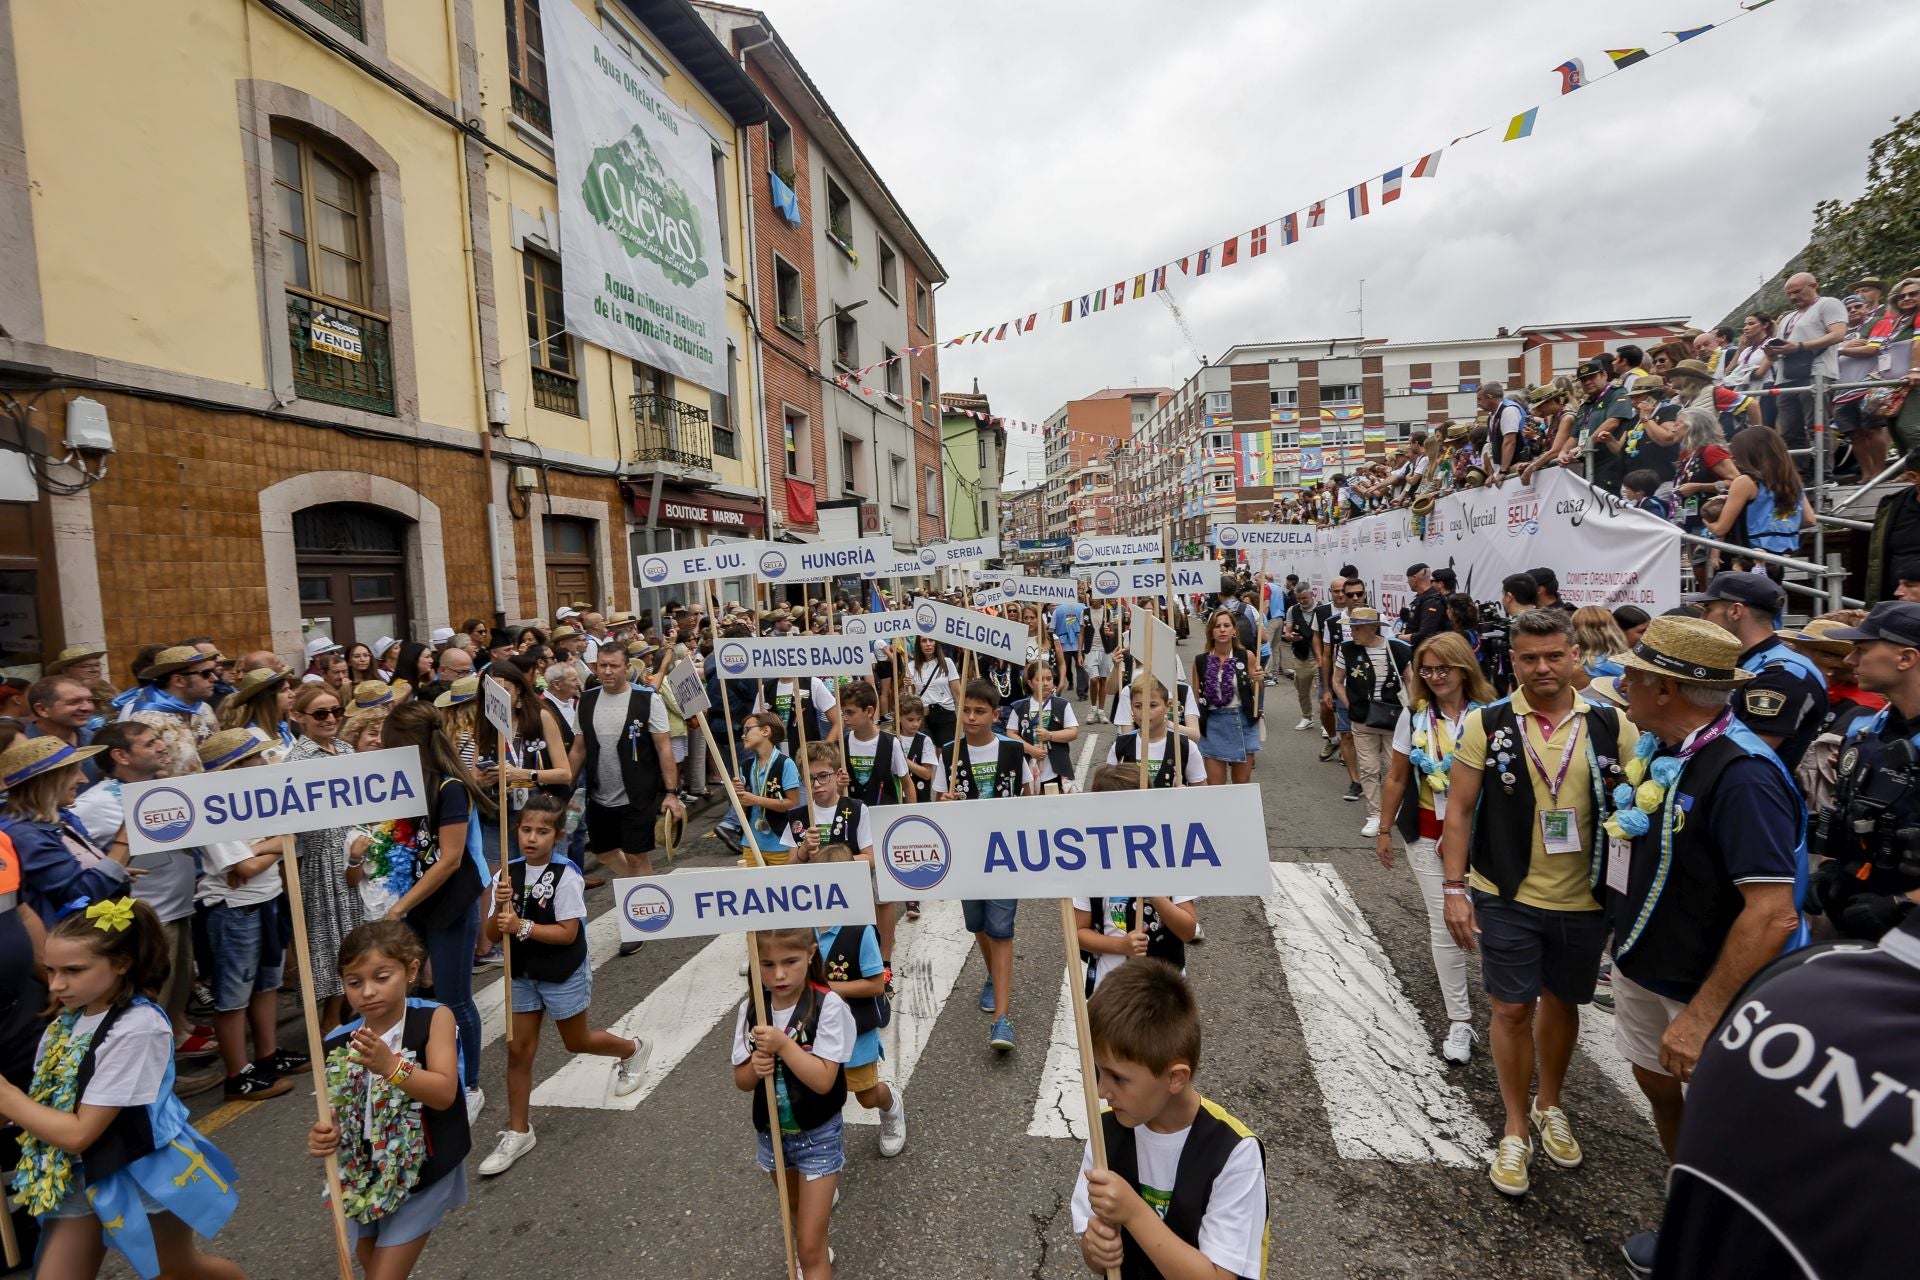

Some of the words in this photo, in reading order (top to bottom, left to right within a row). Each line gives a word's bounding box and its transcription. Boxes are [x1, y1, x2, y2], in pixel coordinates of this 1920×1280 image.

[594, 45, 621, 85] Agua
[624, 73, 655, 114] Oficial
[656, 103, 679, 136] Sella
[605, 272, 634, 303] Agua
[638, 292, 673, 323] mineral
[675, 311, 706, 338] natural
[594, 296, 609, 319] de
[612, 302, 622, 324] la
[624, 311, 670, 345] montaña
[673, 334, 713, 364] asturiana
[312, 329, 363, 353] VENDE
[665, 504, 708, 521] BOUTIQUE
[713, 510, 744, 525] MARIPAZ
[1508, 503, 1538, 524] SELLA
[1556, 499, 1585, 515] casa
[1456, 502, 1496, 541] Marcial
[1241, 532, 1312, 544] VENEZUELA
[801, 546, 875, 569] HUNGRÍA
[947, 546, 983, 560] SERBIA
[1095, 545, 1121, 556] NUEVA
[1122, 542, 1160, 555] ZELANDA
[683, 558, 712, 573] EE.
[716, 553, 746, 569] UU.
[1132, 569, 1203, 588] ESPAÑA
[1566, 571, 1588, 585] COMITÉ
[1590, 572, 1640, 585] ORGANIZADOR
[1019, 584, 1075, 599] ALEMANIA
[1559, 589, 1584, 602] ESCENSO
[1640, 590, 1655, 604] DEL
[874, 618, 914, 633] UCRA
[946, 617, 1011, 651] BÉLGICA
[752, 648, 808, 667] PAISES
[811, 646, 864, 666] BAJOS
[1703, 727, 1719, 740] renfe
[204, 770, 415, 825] SUDÁFRICA
[144, 810, 186, 824] SELLA
[894, 849, 940, 863] SELLA
[983, 822, 1222, 873] AUSTRIA
[632, 905, 666, 916] SELLA
[694, 883, 849, 919] FRANCIA
